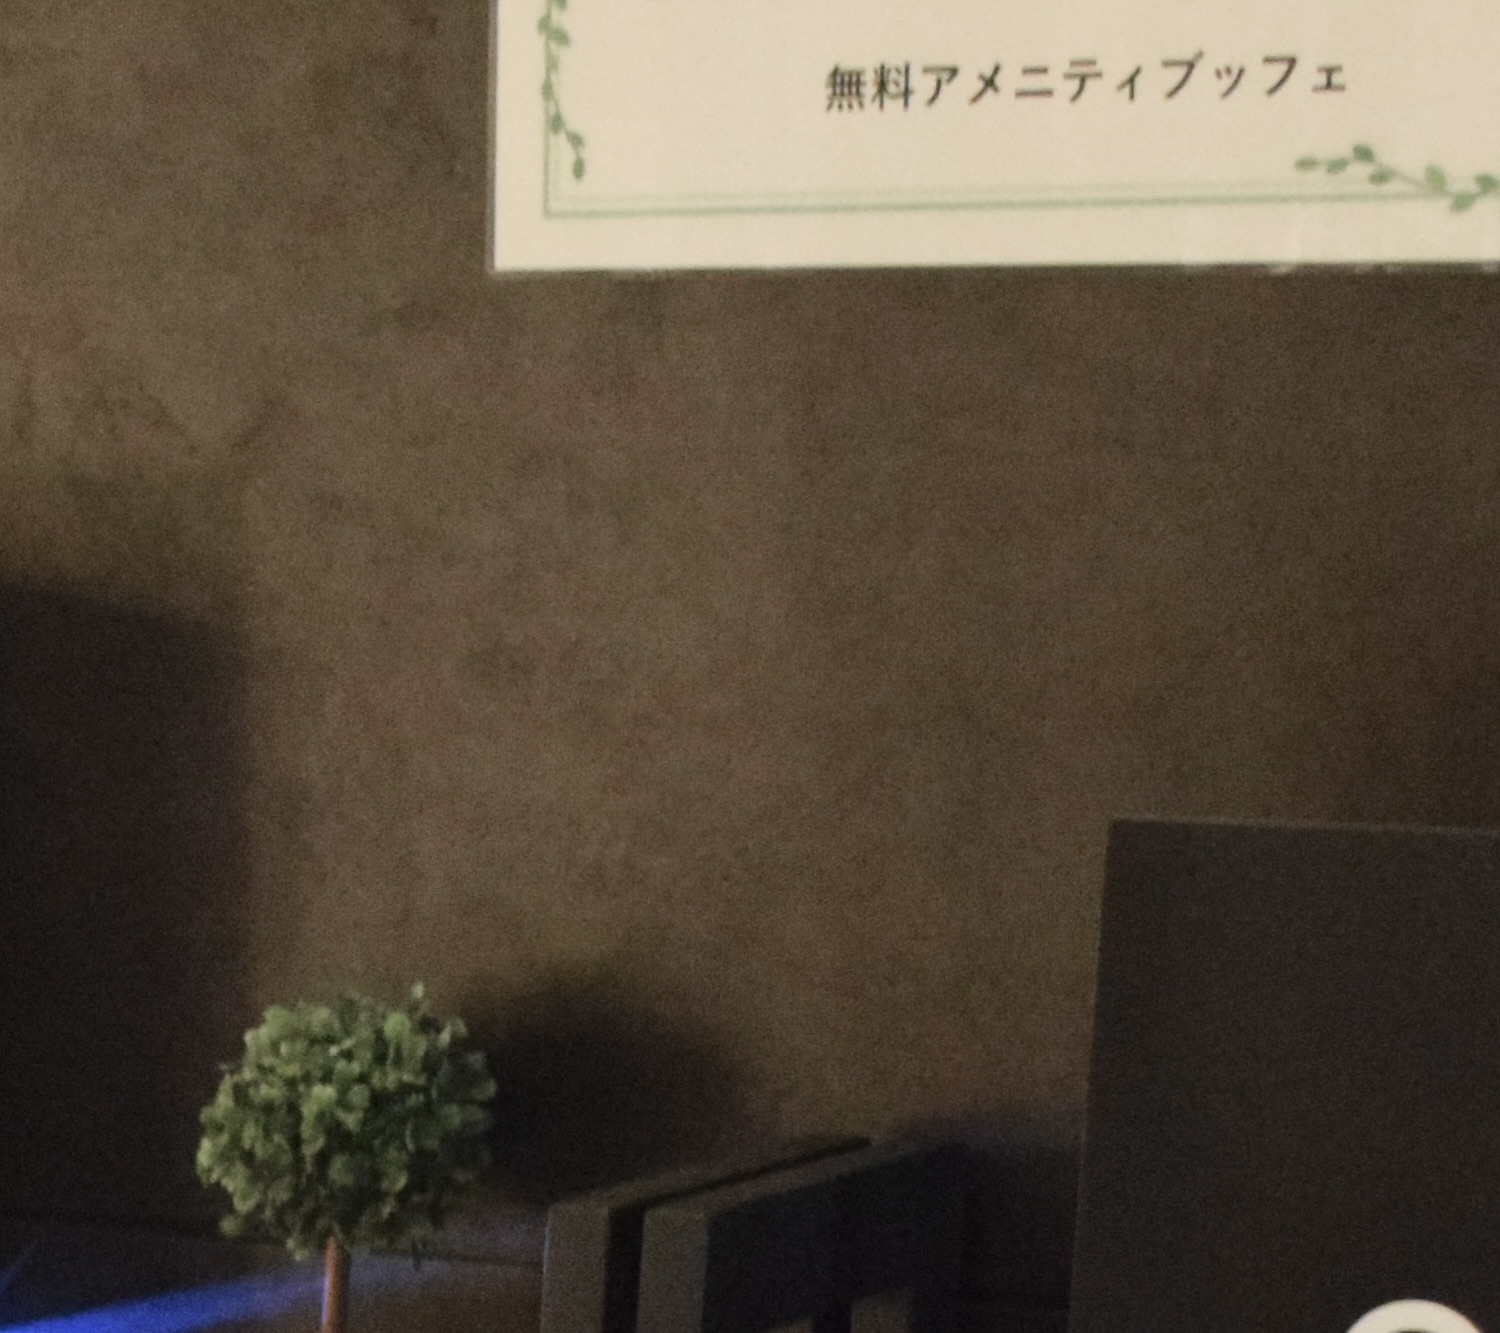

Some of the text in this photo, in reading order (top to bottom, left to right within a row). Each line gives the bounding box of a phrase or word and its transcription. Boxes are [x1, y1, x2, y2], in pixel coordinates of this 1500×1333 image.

[824, 51, 1349, 112] 無料アメニティブッフェ
